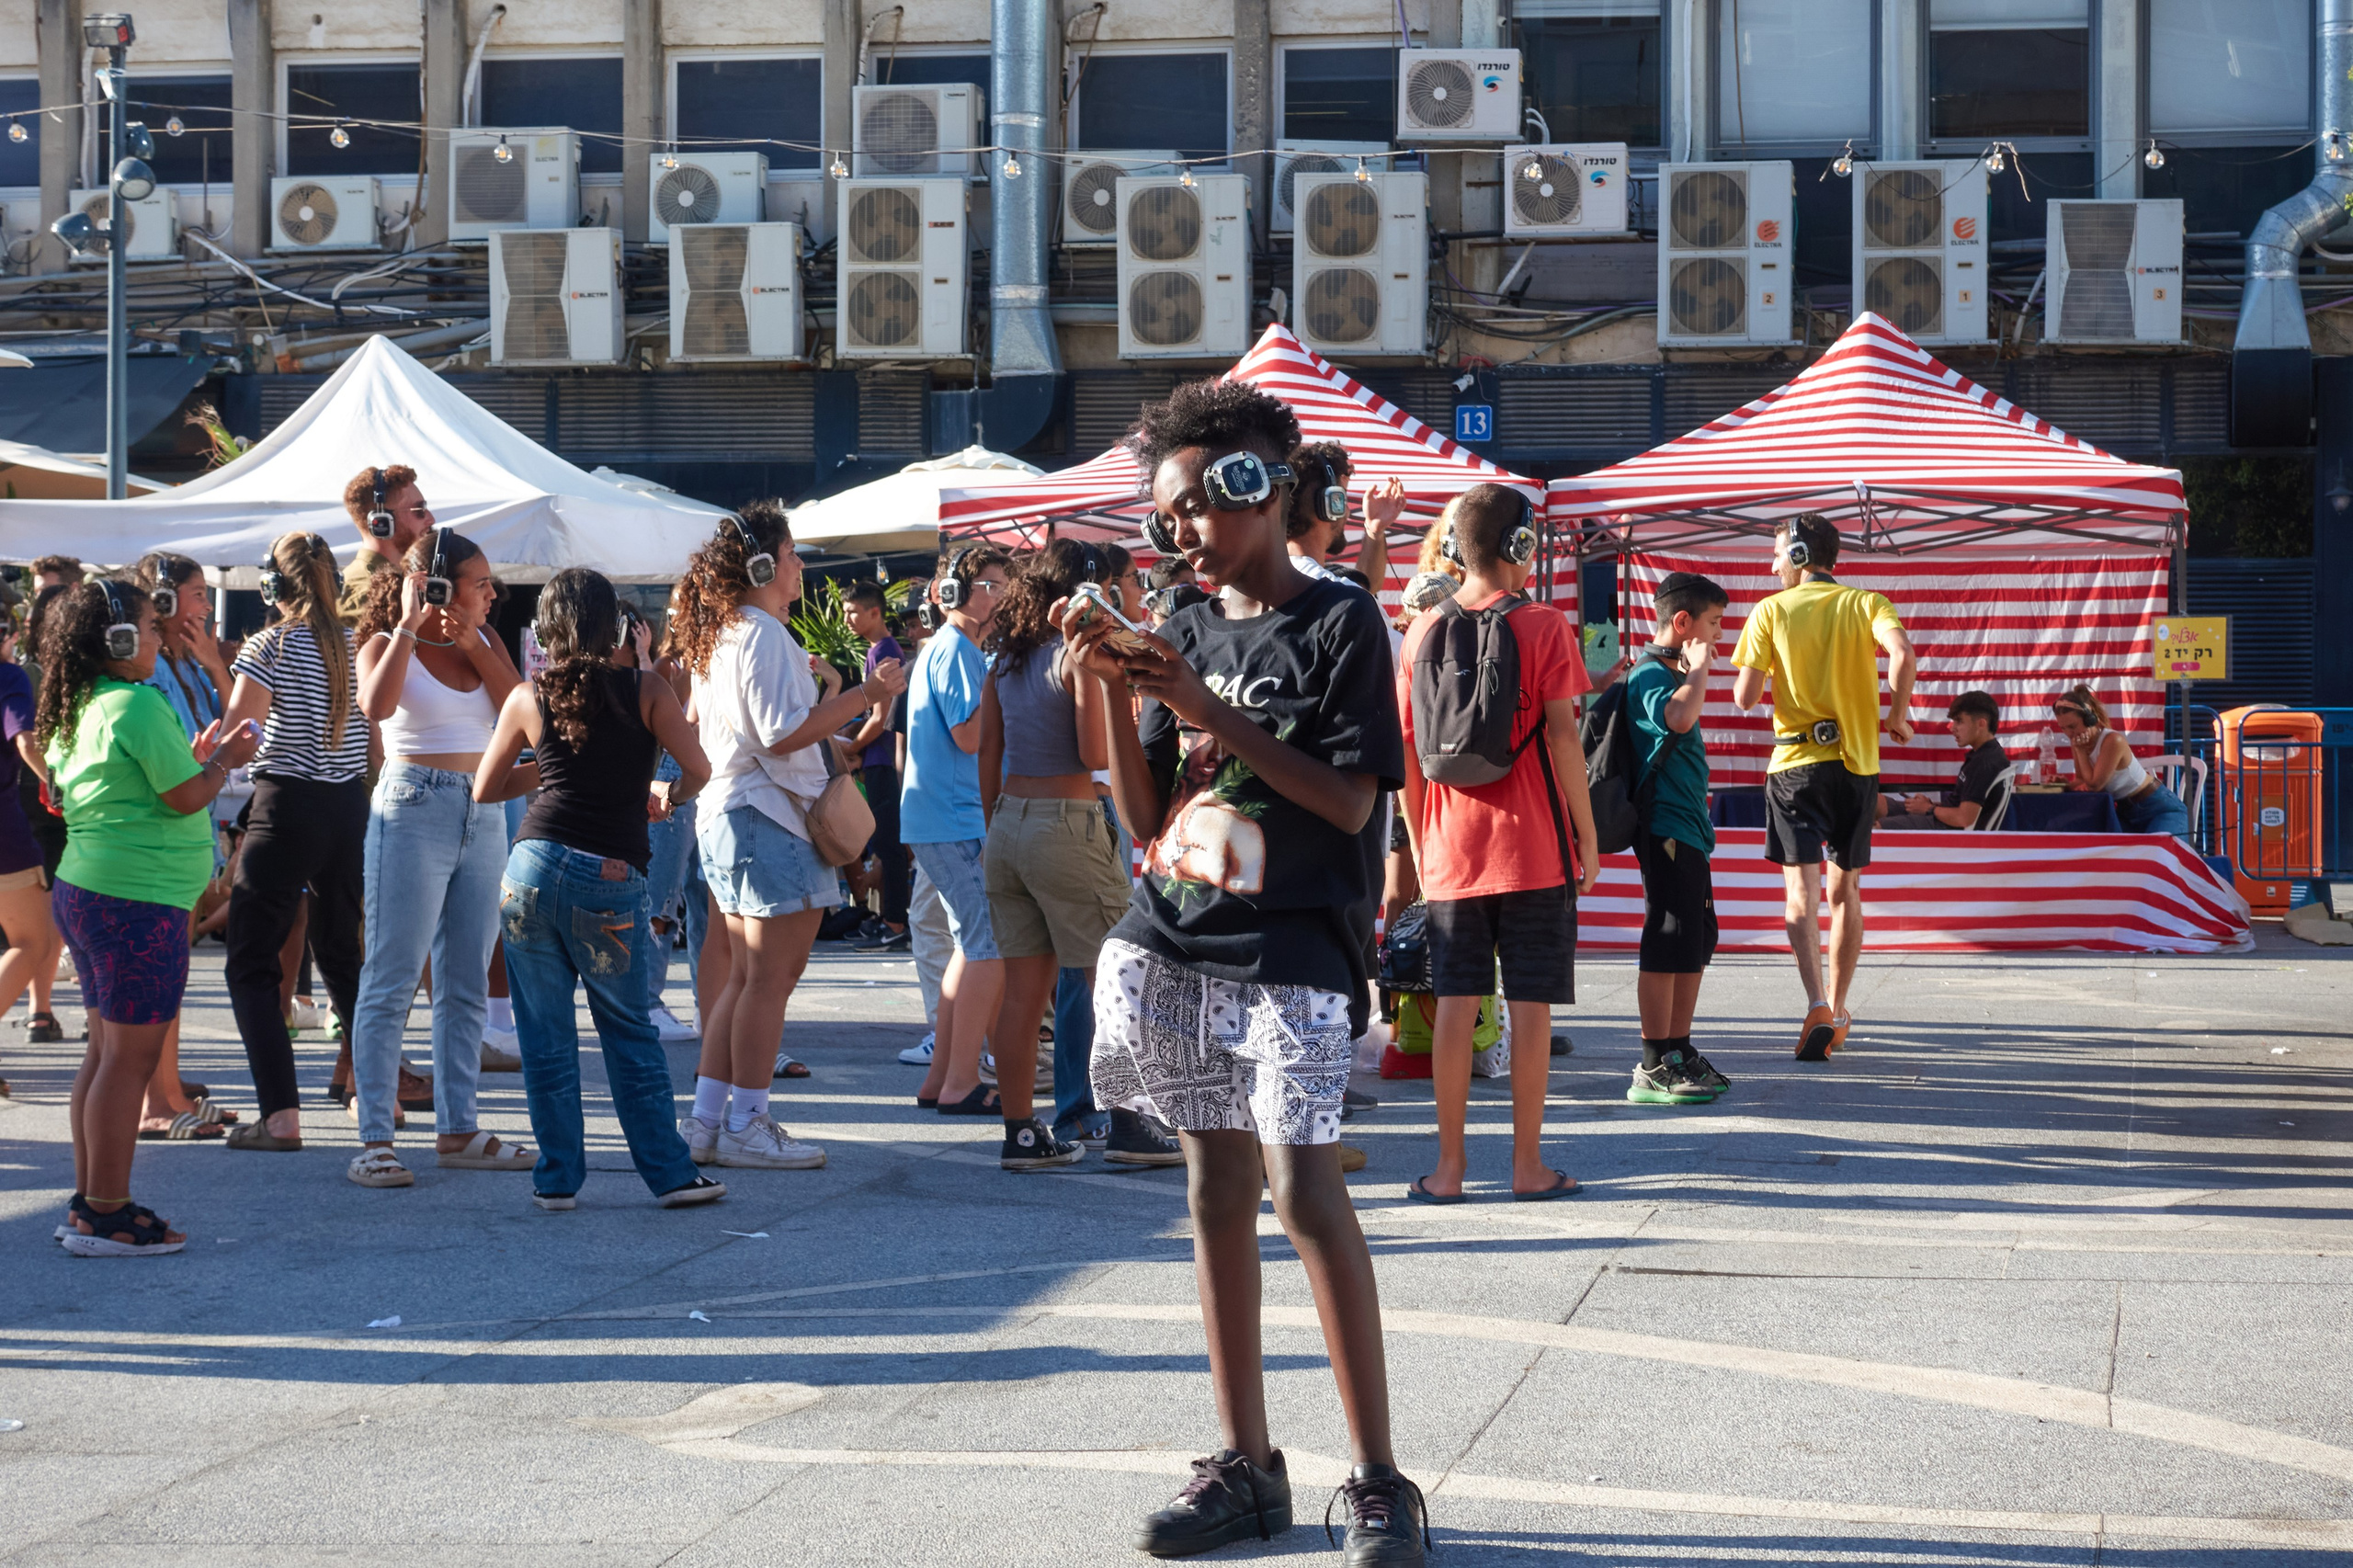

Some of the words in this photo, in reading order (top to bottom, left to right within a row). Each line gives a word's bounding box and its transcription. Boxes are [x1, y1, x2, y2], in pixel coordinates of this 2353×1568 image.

[1477, 62, 1510, 71] טורנדו
[1584, 157, 1617, 165] טורנדו
[1765, 294, 1773, 304] 2
[1962, 291, 1969, 301] 1
[2156, 290, 2164, 300] 3
[1461, 411, 1488, 436] 13
[2164, 648, 2171, 659] 2
[2175, 648, 2188, 658] יד
[2194, 648, 2213, 661] רק
